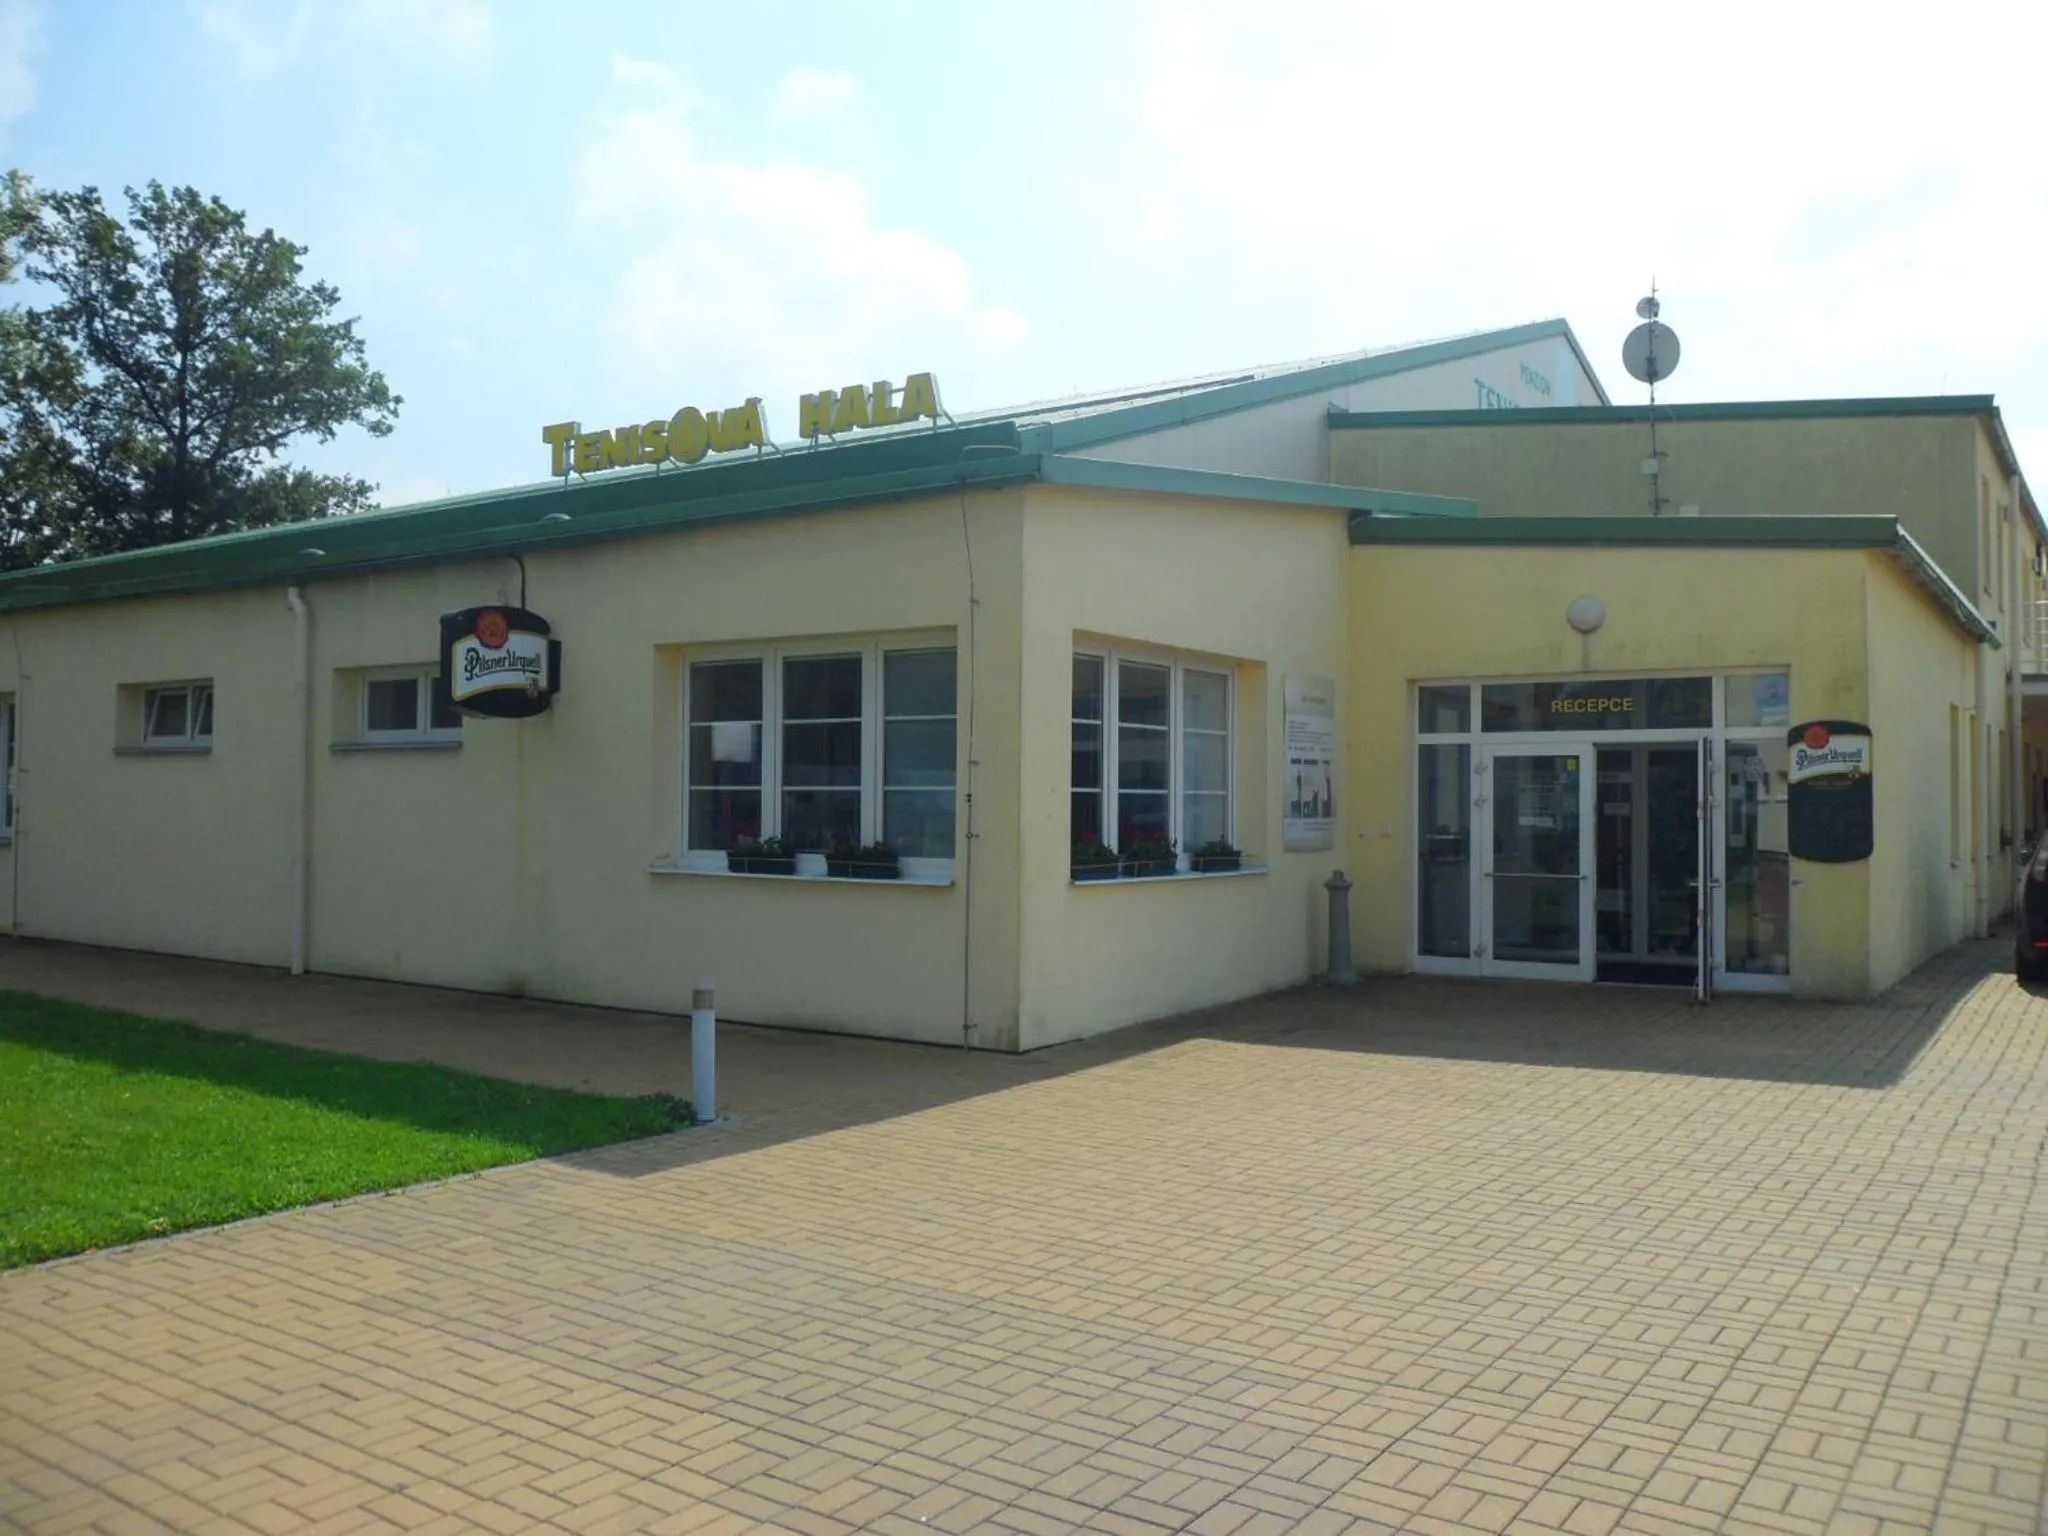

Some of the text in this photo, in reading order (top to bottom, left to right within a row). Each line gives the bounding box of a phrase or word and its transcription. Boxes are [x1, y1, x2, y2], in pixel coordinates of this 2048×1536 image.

[800, 373, 943, 438] HALA
[464, 647, 542, 681] Pilsner Urquell
[1551, 698, 1633, 713] RECEPCE
